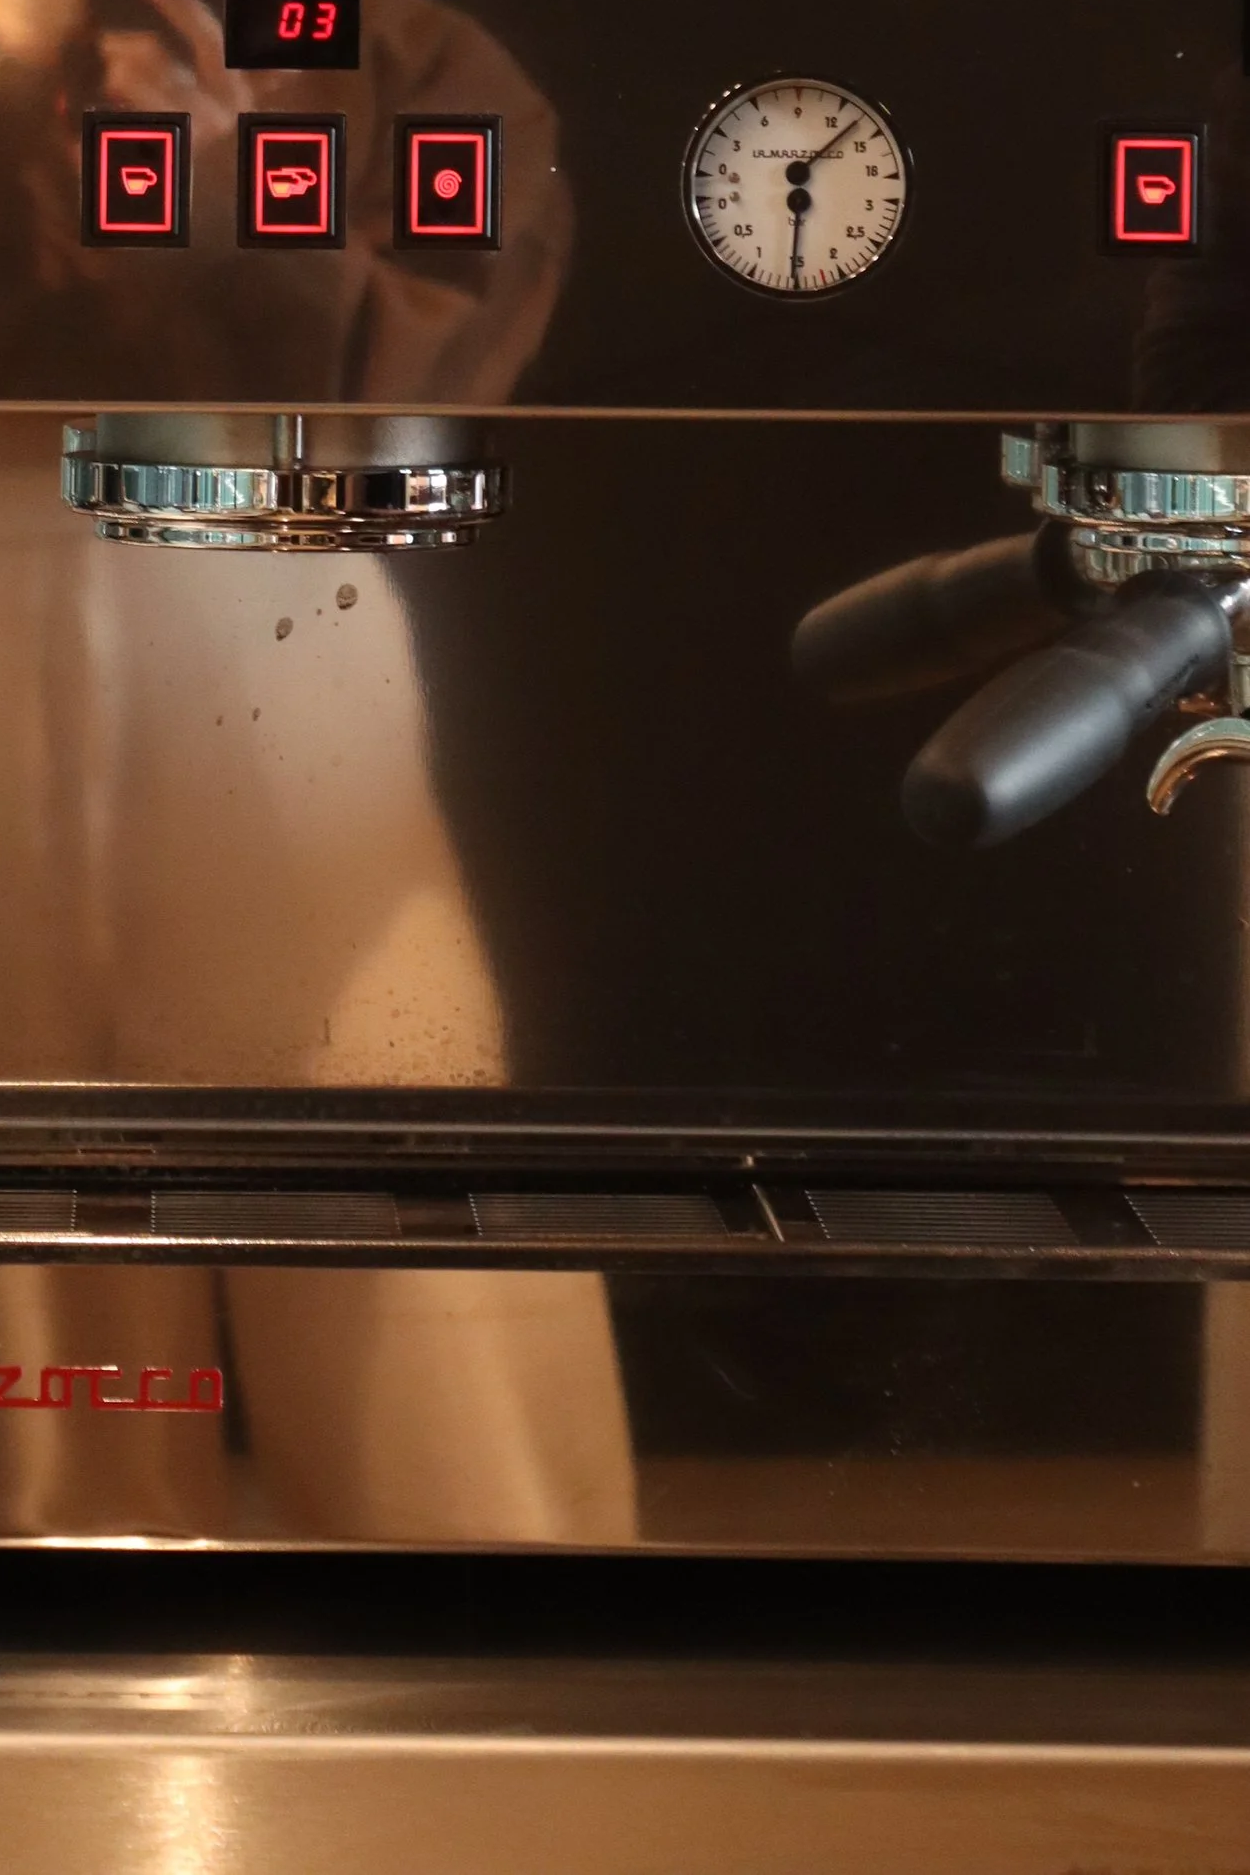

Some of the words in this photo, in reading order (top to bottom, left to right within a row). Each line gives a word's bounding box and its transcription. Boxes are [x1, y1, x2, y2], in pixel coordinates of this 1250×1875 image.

[278, 2, 337, 40] 03
[793, 107, 803, 119] 9
[760, 116, 770, 127] 6
[824, 116, 839, 129] 12
[732, 140, 742, 152] 3
[854, 140, 867, 153] 15
[719, 163, 727, 175] 0
[865, 165, 879, 177] 18
[718, 198, 727, 210] 0
[865, 199, 874, 211] 3
[734, 224, 753, 238] 0,5
[846, 226, 865, 240] 2,5
[756, 246, 762, 259] 1
[829, 247, 839, 260] 2
